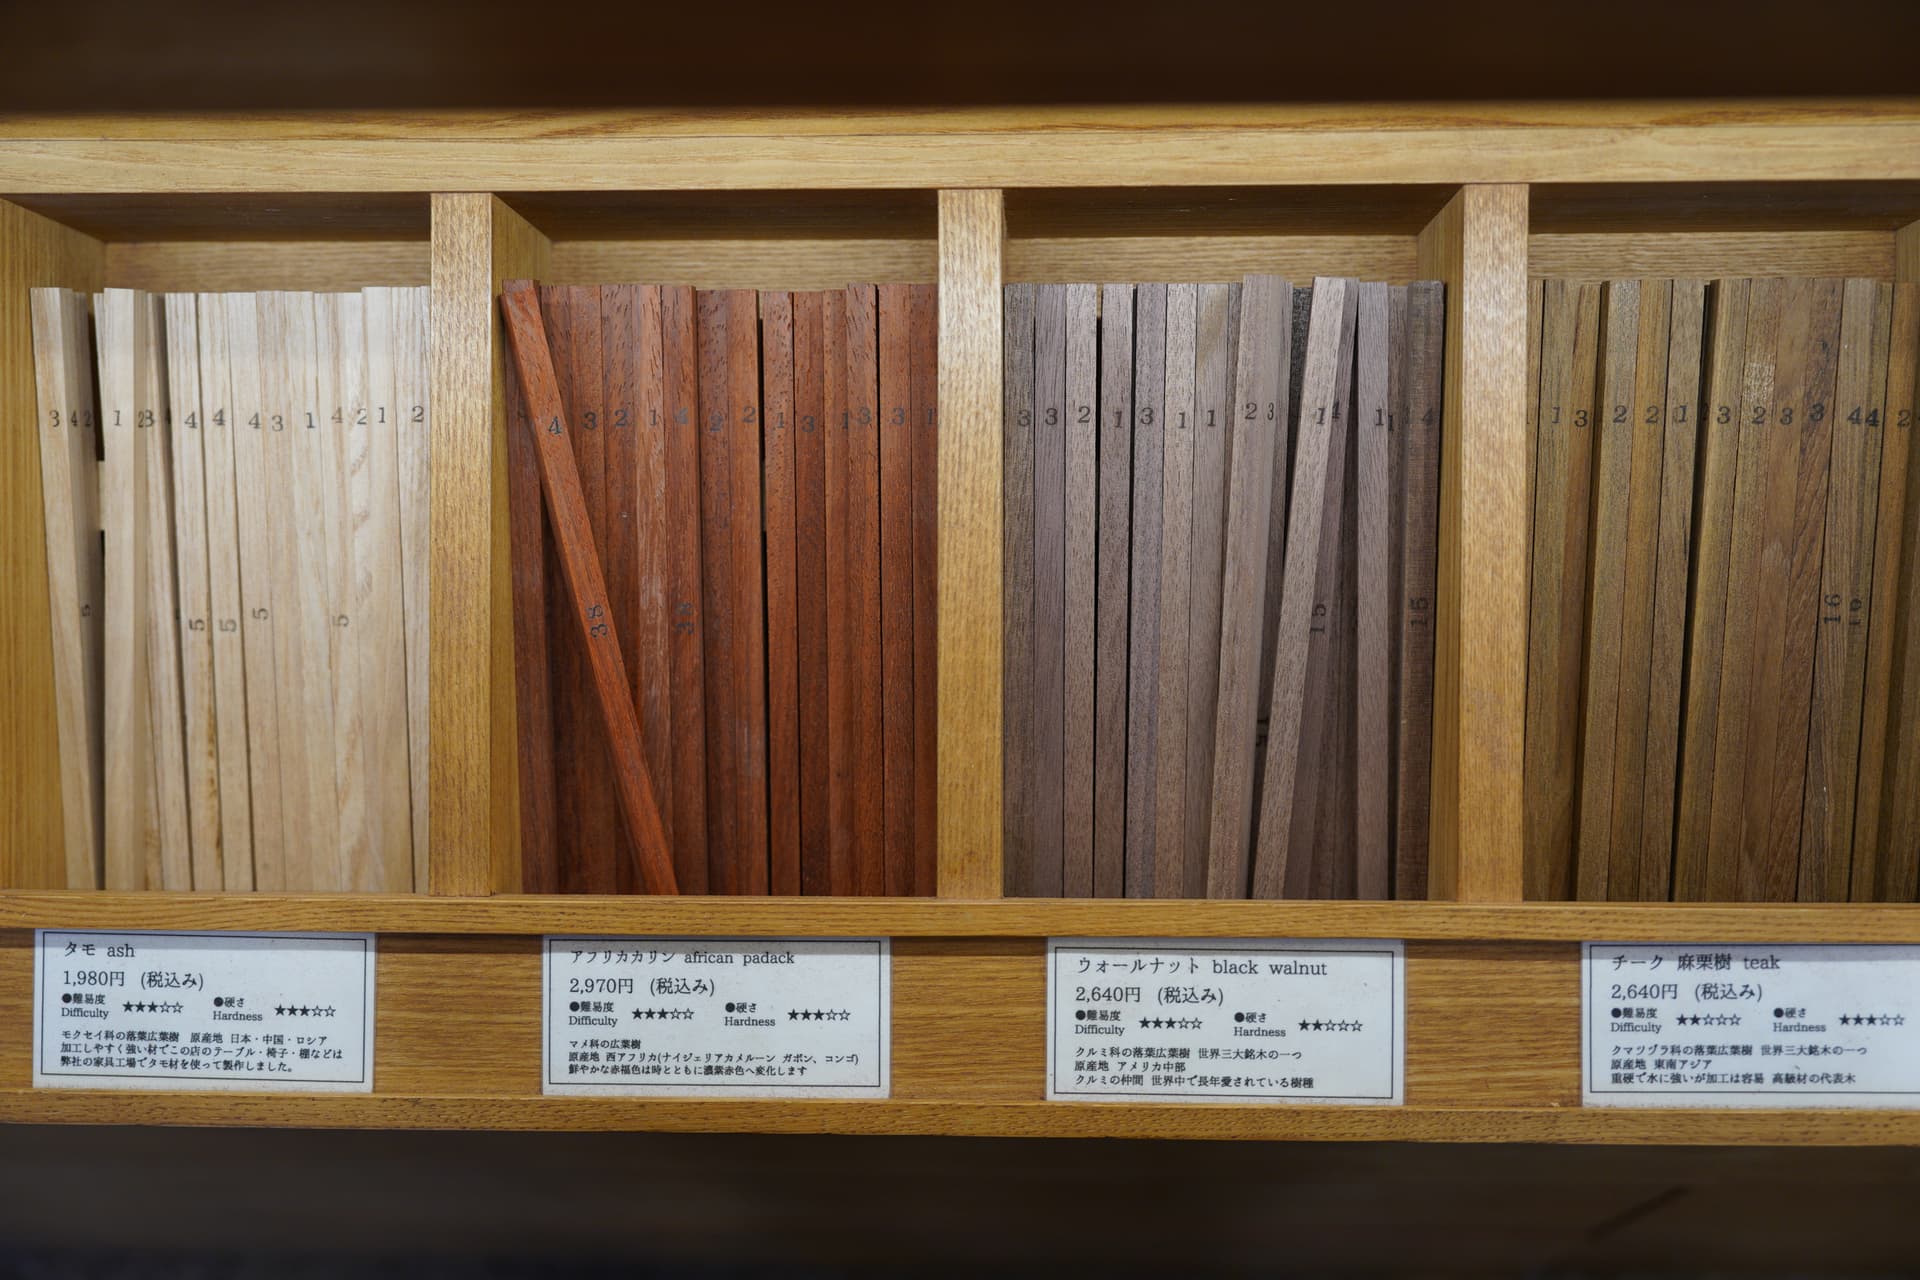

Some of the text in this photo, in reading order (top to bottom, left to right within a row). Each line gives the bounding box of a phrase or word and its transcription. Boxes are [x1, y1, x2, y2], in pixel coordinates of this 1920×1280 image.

[49, 409, 60, 427] 3
[70, 410, 78, 427] 4
[113, 410, 122, 426] 1
[184, 411, 198, 429] 4
[212, 408, 225, 426] 4
[331, 406, 343, 423] 4
[357, 408, 367, 425] 2
[378, 406, 386, 423] 1
[411, 405, 425, 423] 2
[614, 409, 629, 427] 2
[648, 409, 657, 426] 1
[743, 405, 756, 423] 2
[776, 411, 785, 429] 1
[857, 406, 872, 425] 3
[892, 407, 905, 426] 3
[1017, 409, 1031, 427] 3
[1045, 407, 1058, 426] 3
[1078, 405, 1091, 423] 2
[1113, 410, 1123, 429] 1
[1140, 407, 1154, 425] 3
[1178, 411, 1186, 429] 1
[1207, 409, 1216, 427] 1
[1244, 402, 1257, 420] 2
[1267, 402, 1275, 420] 3
[1315, 407, 1325, 425] 1
[1375, 408, 1384, 426] 1
[1551, 406, 1561, 424] 1
[1574, 409, 1588, 428] 3
[1613, 405, 1627, 423] 2
[1645, 405, 1659, 424] 2
[1678, 405, 1688, 422] 1
[1717, 405, 1731, 424] 3
[1751, 406, 1766, 424] 2
[1847, 406, 1862, 425] 4
[1865, 407, 1880, 427] 4
[1897, 409, 1911, 428] 2
[248, 412, 261, 429] 4
[271, 415, 284, 432] 3
[305, 412, 316, 429] 1
[548, 415, 562, 434] 4
[582, 411, 597, 430] 3
[801, 415, 815, 433] 3
[252, 607, 269, 620] 5
[1824, 594, 1841, 624] 16
[188, 619, 205, 631] 5
[219, 619, 237, 632] 5
[64, 941, 135, 958] タモ ash
[571, 950, 795, 967] アフリカカリン african padack
[1078, 957, 1328, 976] ウォールナット black walnut
[1611, 954, 1664, 970] チーク
[1744, 954, 1780, 970] teak
[63, 970, 204, 991] 1,980円 (税込み)
[569, 977, 715, 996] 2,970円 (税込み)
[1075, 986, 1224, 1006] 2,640円 (税込み)
[1611, 983, 1763, 1002] 2,640円 (税込み)
[224, 997, 245, 1008] 硬さ
[735, 1002, 757, 1014] 硬さ
[61, 1007, 109, 1020] Difficulty
[213, 1010, 263, 1022] Hardness
[724, 1016, 776, 1027] Hardness
[1245, 1012, 1267, 1024] 硬さ
[1784, 1007, 1807, 1019] 硬さ
[568, 1016, 618, 1029] Difficulty
[1074, 1024, 1125, 1037] Difficulty
[1610, 1021, 1662, 1034] Difficulty
[1773, 1022, 1826, 1033] Hardness
[190, 1032, 223, 1044] 原産地
[1233, 1026, 1286, 1038] Hardness
[569, 1039, 641, 1050] マメ科の広葉樹
[1075, 1046, 1190, 1059] クルミ科の落葉広葉樹
[568, 1051, 600, 1063] 原産地
[1654, 1059, 1712, 1071] 東南アジア
[1074, 1060, 1186, 1073] 原産地 アメリカ中部
[1075, 1074, 1144, 1087] クルミの仲間
